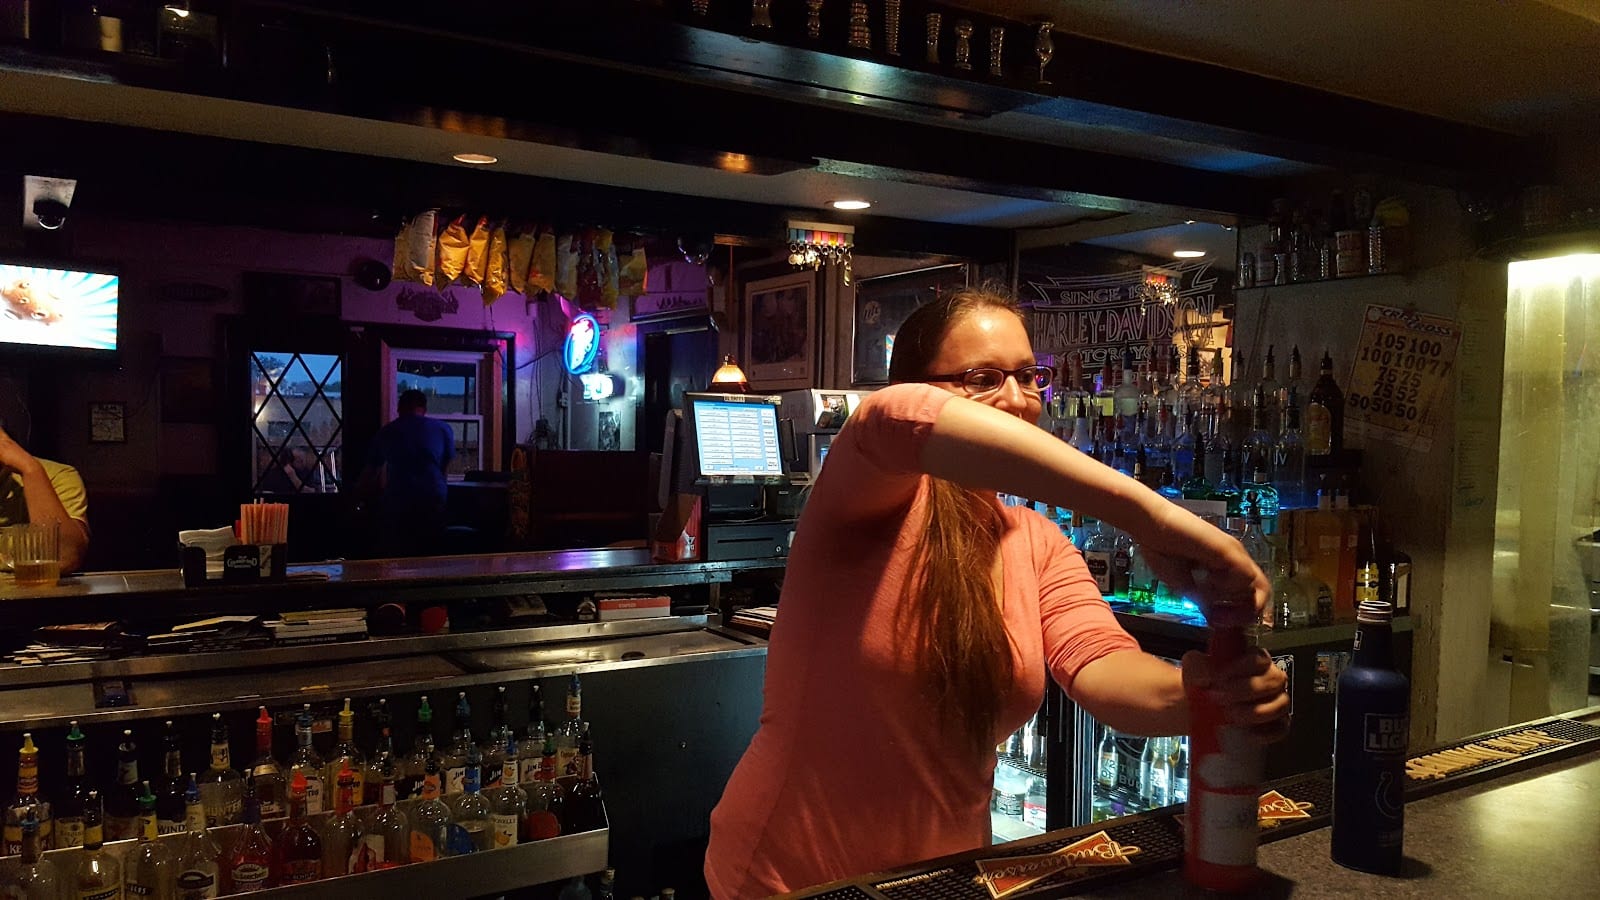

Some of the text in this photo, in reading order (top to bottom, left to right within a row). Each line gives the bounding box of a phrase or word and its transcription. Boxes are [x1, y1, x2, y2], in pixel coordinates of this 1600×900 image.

[1060, 287, 1121, 305] SINCE
[1033, 294, 1215, 350] HARLEY-DAVIDSON
[1054, 344, 1188, 365] MOTORCYCS
[1375, 332, 1442, 357] 105 100
[1361, 346, 1392, 365] 100
[1394, 353, 1426, 371] 100
[1377, 366, 1423, 388] 75 75
[1373, 381, 1418, 404] 75 52
[1350, 394, 1417, 420] 50 50 50
[1369, 734, 1407, 750] LIG
